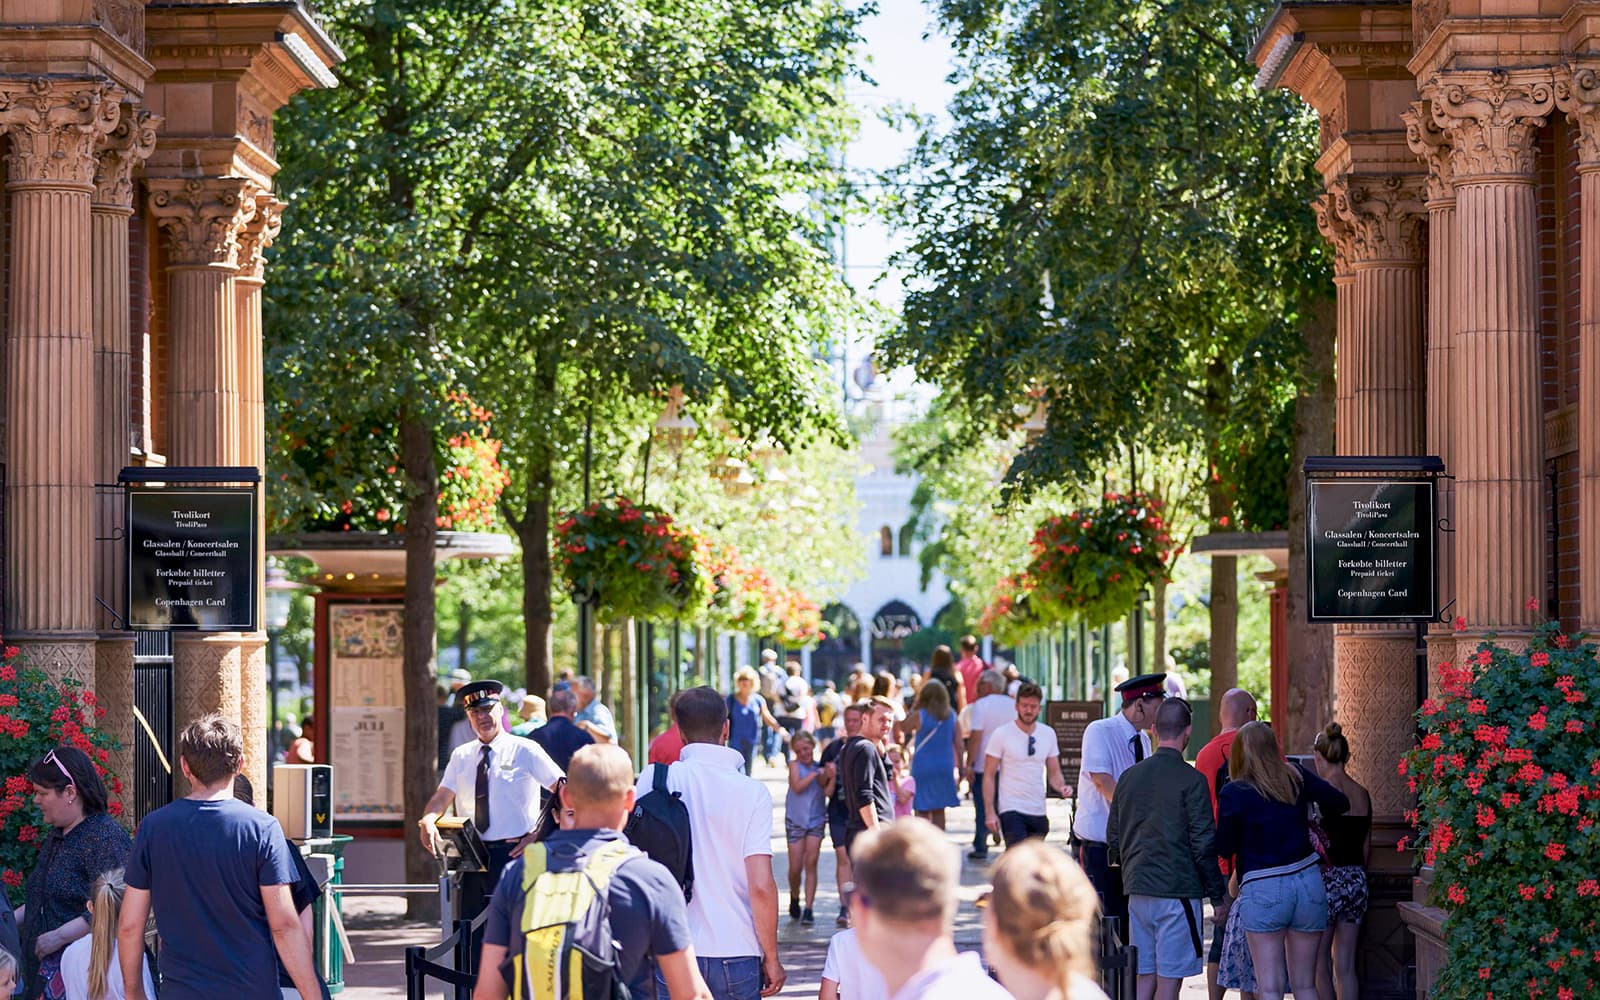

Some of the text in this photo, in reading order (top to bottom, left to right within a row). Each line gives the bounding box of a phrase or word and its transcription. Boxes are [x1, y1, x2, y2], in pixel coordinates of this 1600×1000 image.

[1353, 501, 1391, 509] Tivolikort
[172, 511, 210, 519] Tivolikort
[1325, 530, 1362, 539] Glassalen
[1369, 530, 1420, 539] Koncertsalen
[143, 539, 181, 548] Glassalen
[187, 539, 239, 548] Koncertsalen
[1337, 540, 1366, 548] Glasshall
[1371, 540, 1408, 548] Concerthall
[1375, 559, 1407, 568] billetter
[193, 568, 226, 577] billetter
[1350, 570, 1375, 578] Prepaid
[168, 579, 193, 587] Prepaid
[1338, 589, 1408, 599] Copenhagen Card
[155, 598, 226, 607] Copenhagen Card
